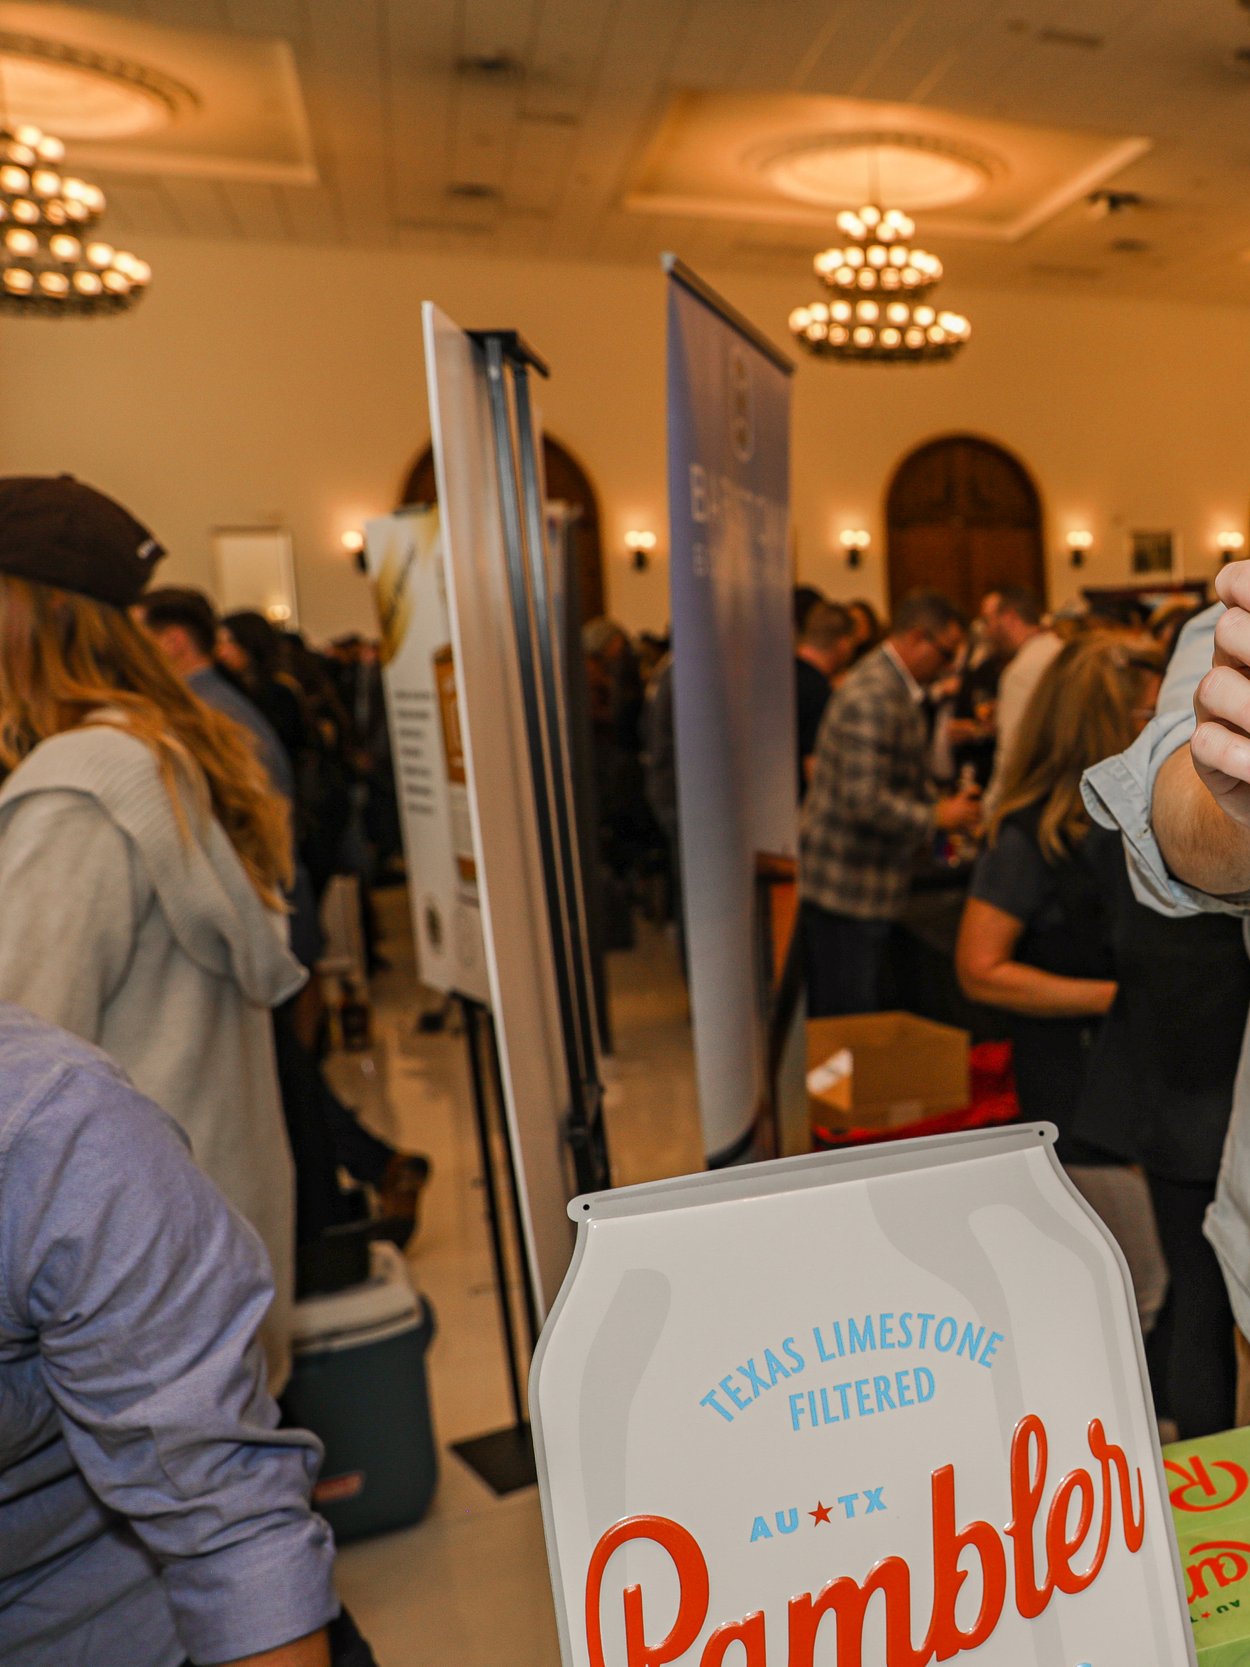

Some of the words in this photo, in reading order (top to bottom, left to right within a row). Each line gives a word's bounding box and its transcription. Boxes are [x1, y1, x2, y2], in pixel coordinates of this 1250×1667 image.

[700, 1337, 804, 1423] TEXAS
[812, 1311, 1006, 1369] LIMESTONE
[788, 1366, 936, 1431] FILTERED
[748, 1508, 800, 1542] AU
[837, 1487, 888, 1519] TX
